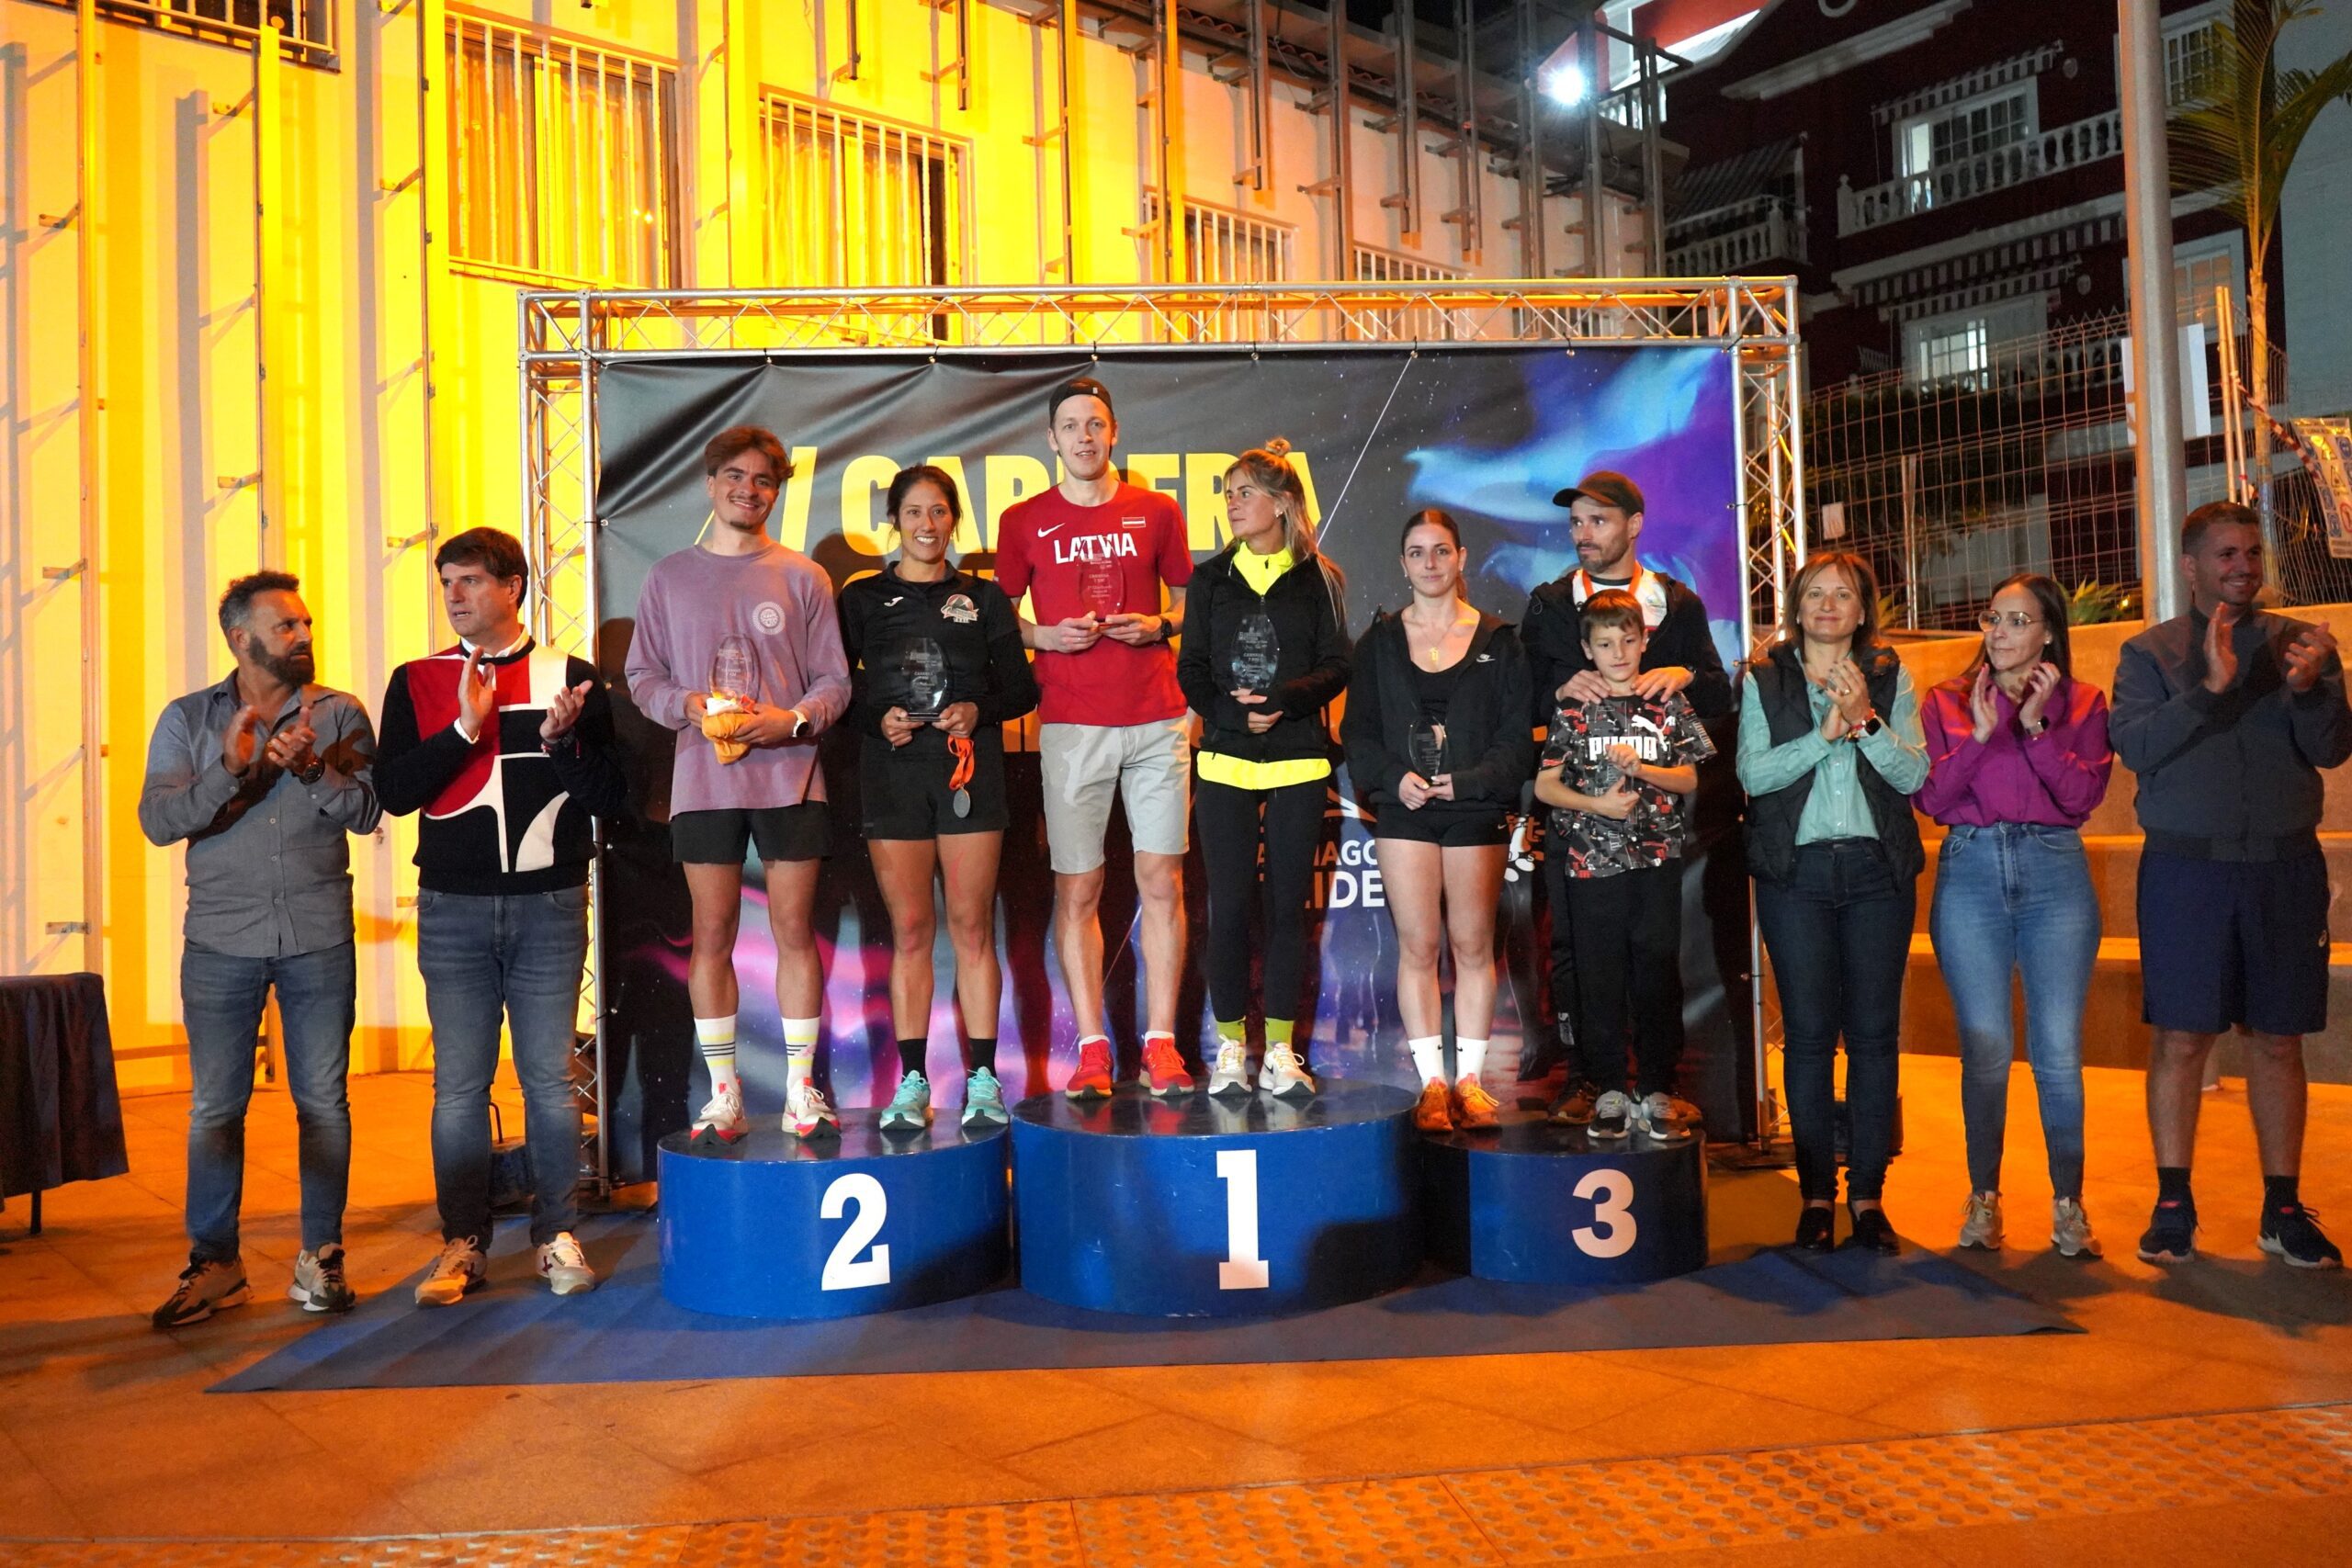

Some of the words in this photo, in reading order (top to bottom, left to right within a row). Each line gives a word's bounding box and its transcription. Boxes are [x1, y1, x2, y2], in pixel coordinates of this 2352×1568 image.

[1053, 533, 1137, 564] LATVIA
[820, 1173, 890, 1292] 2
[1216, 1150, 1269, 1290] 1
[1571, 1168, 1637, 1258] 3
